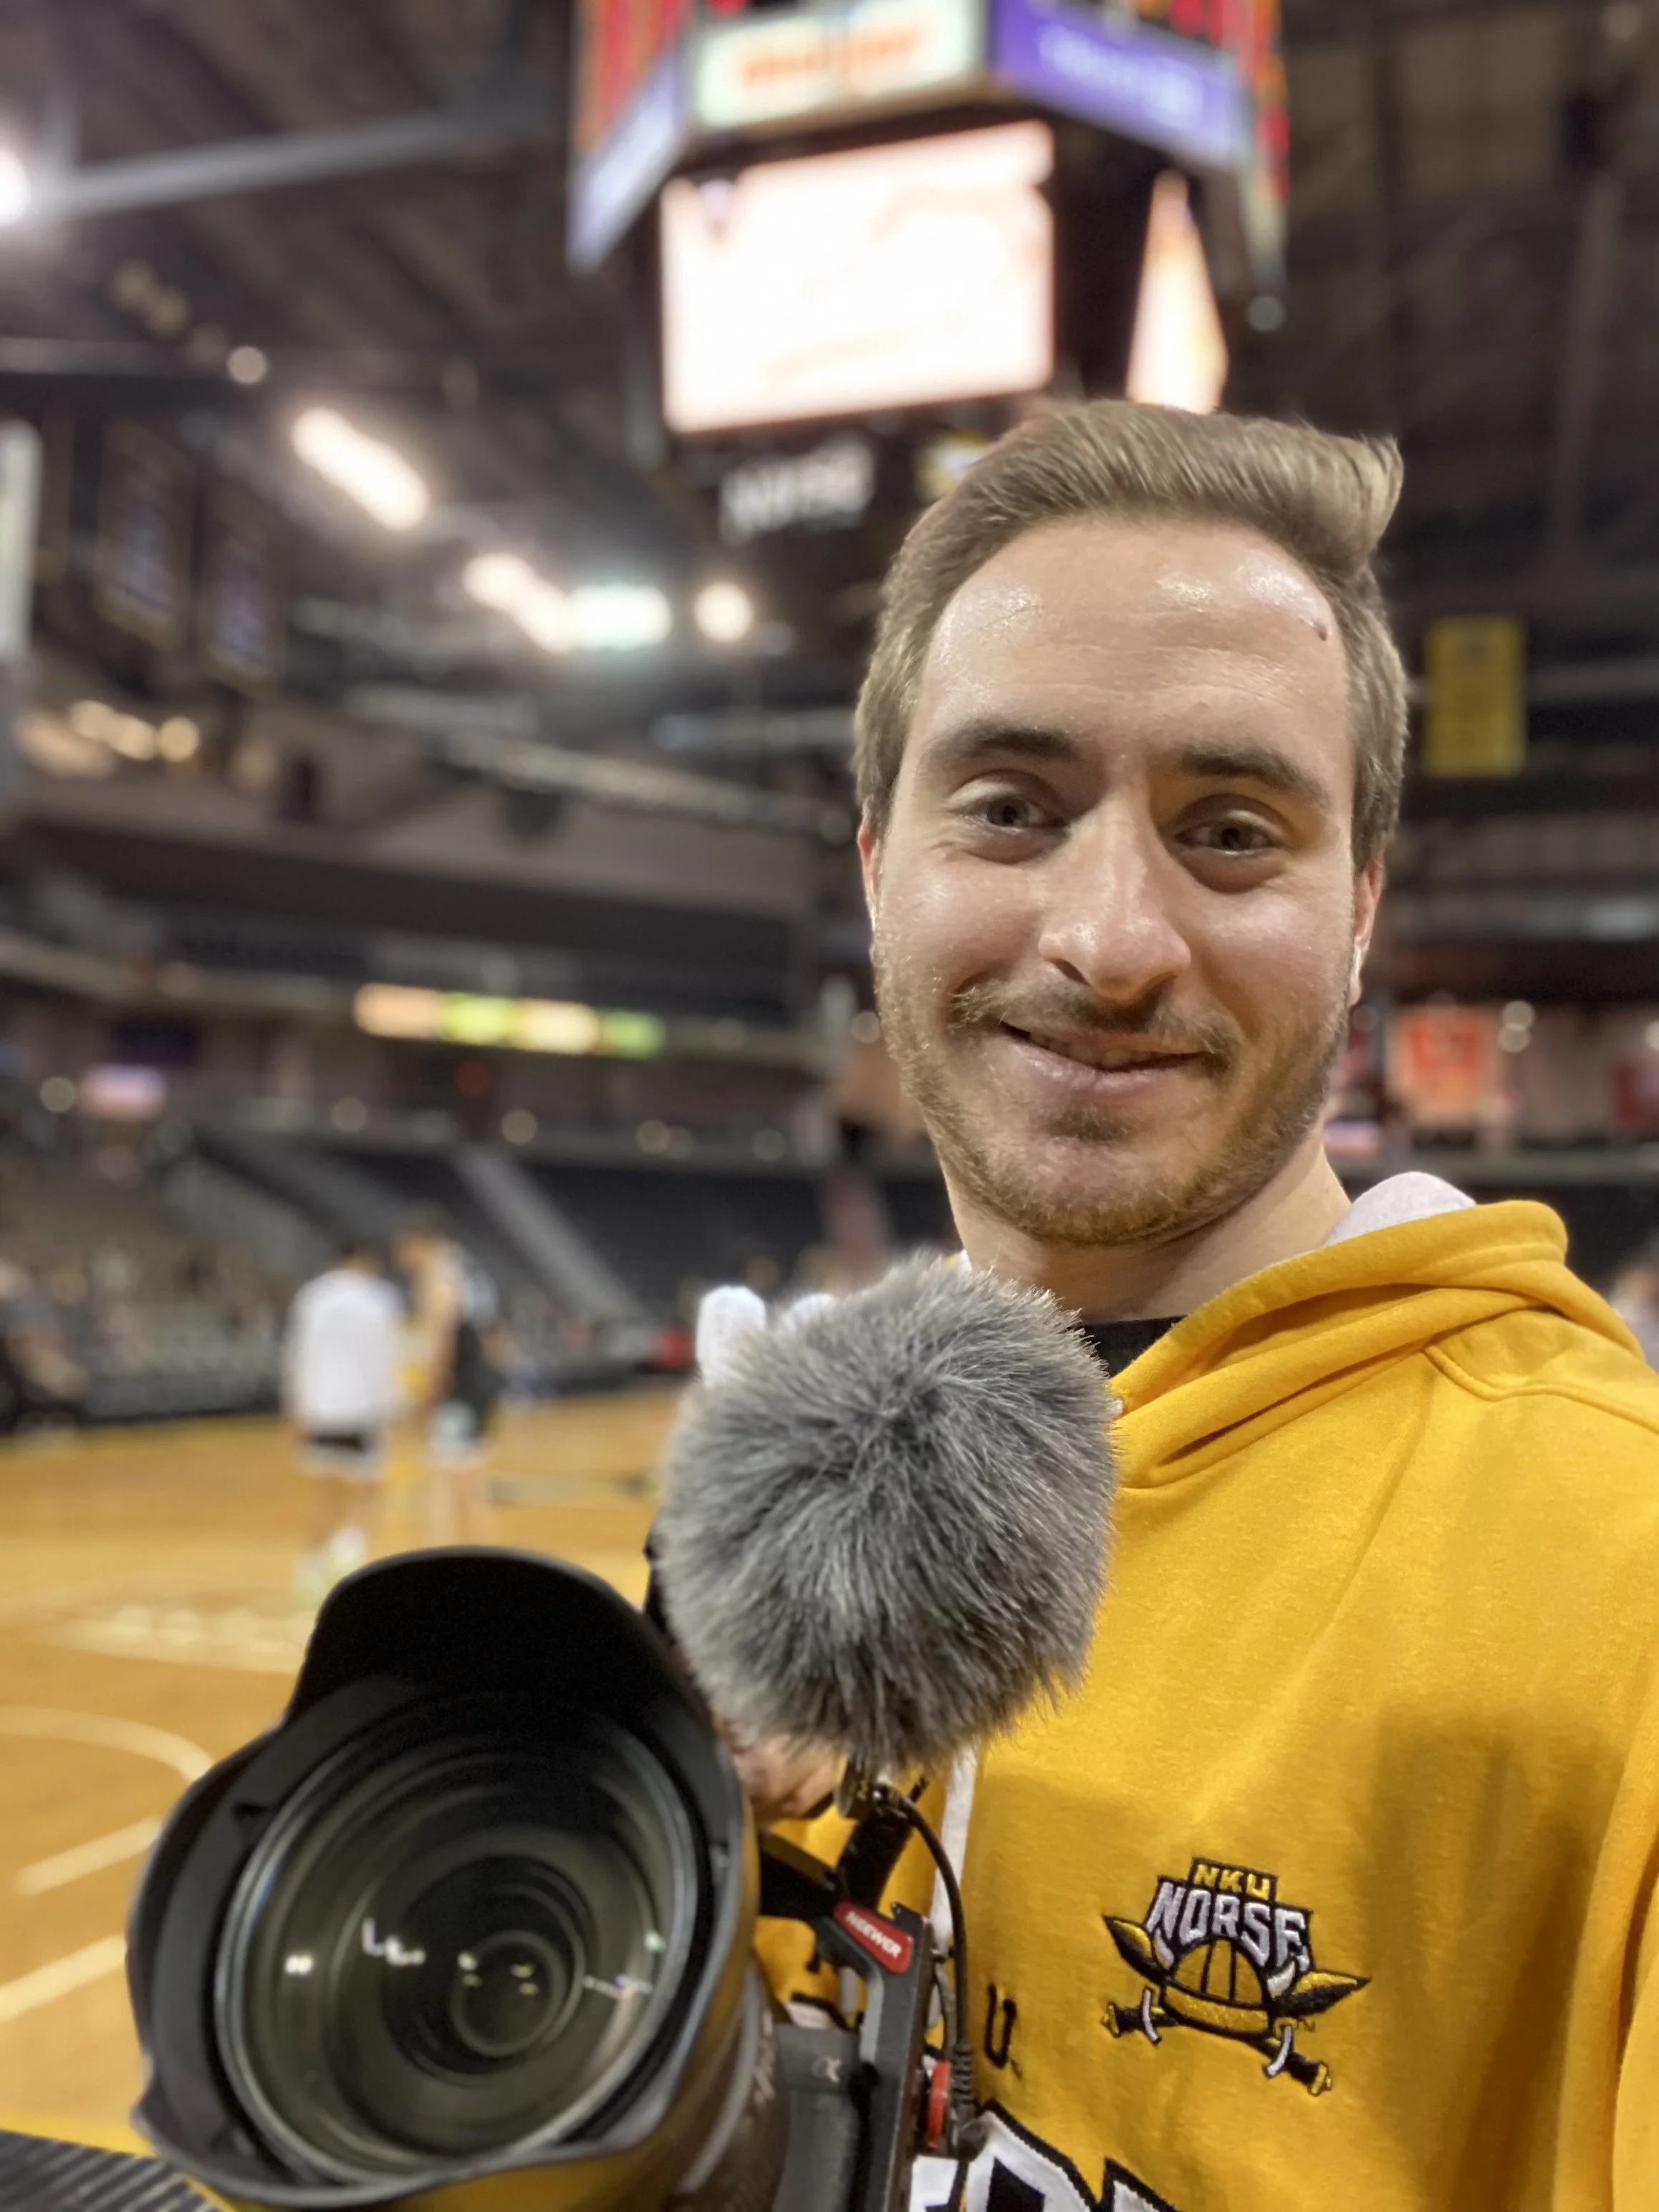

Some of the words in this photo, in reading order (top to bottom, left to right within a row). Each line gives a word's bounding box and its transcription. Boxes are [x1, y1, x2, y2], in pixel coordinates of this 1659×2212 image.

[1193, 1863, 1271, 1900] NKU
[845, 1910, 903, 1959] NEEWER
[1145, 1880, 1312, 1972] NORSE
